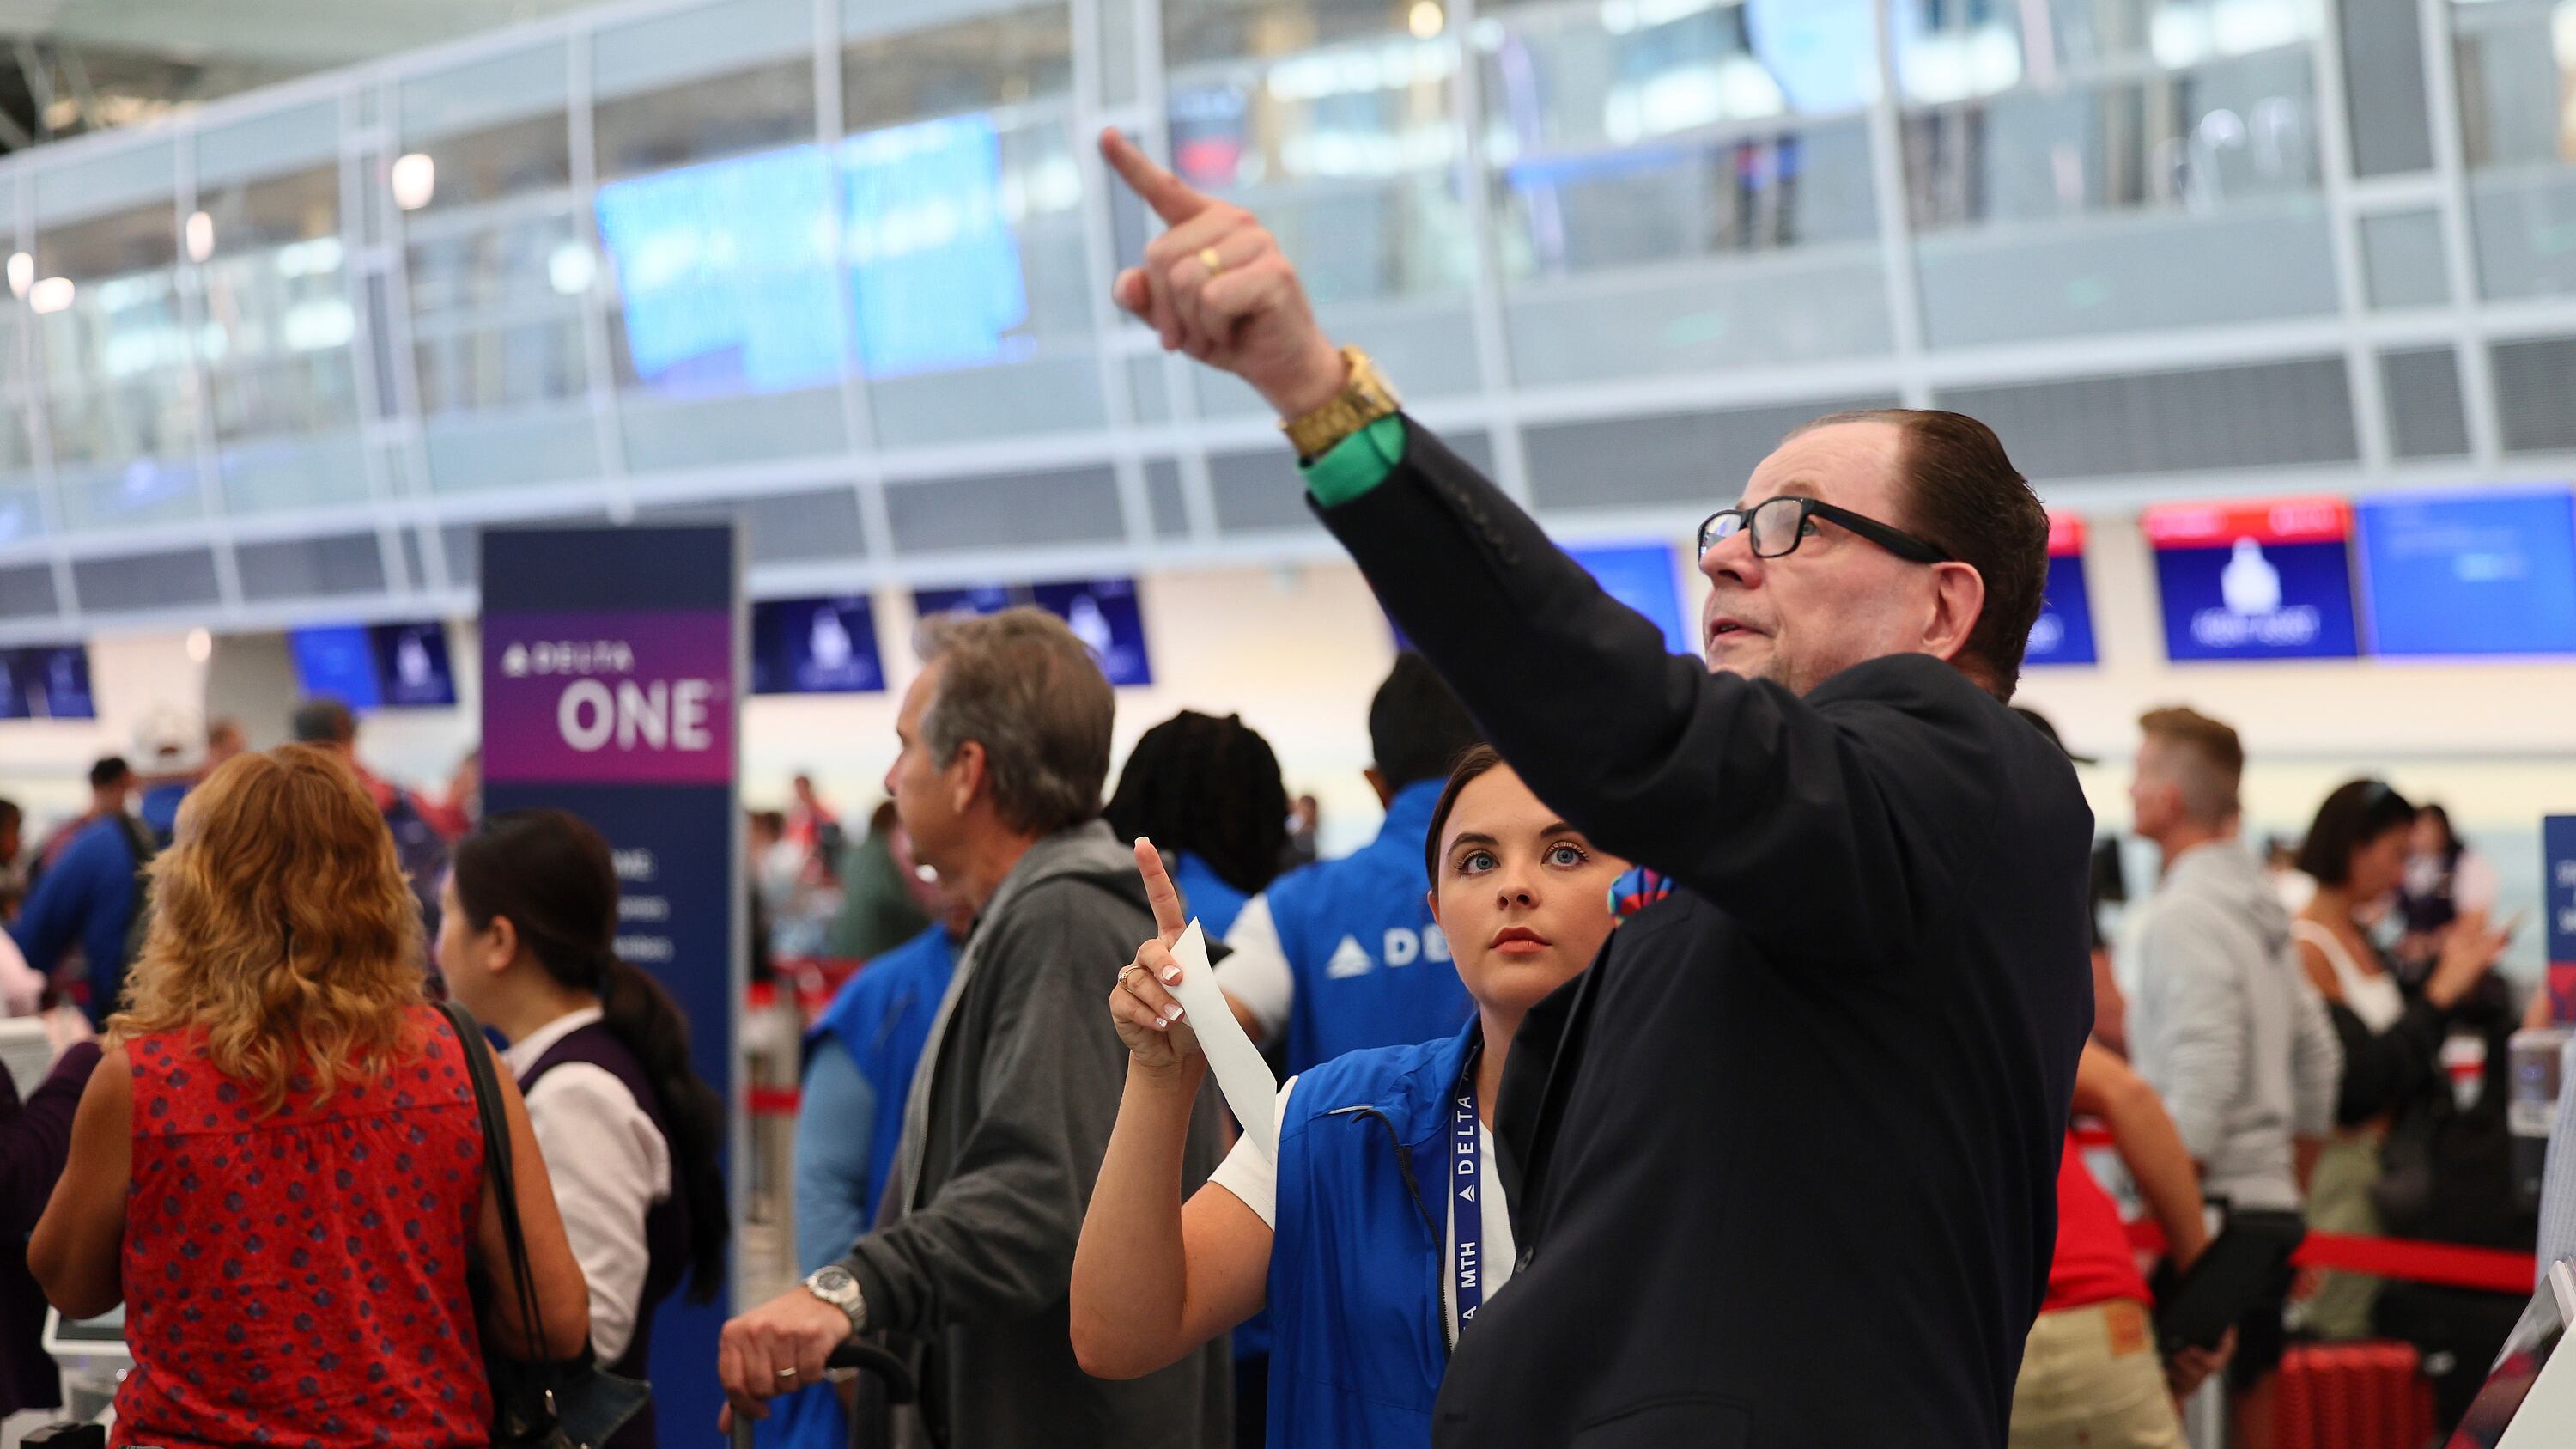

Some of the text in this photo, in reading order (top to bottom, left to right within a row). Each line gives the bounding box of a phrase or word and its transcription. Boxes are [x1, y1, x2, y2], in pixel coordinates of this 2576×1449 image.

[558, 678, 714, 752] ONE
[1457, 1096, 1474, 1175] DELTA
[1460, 1242, 1476, 1288] MTH
